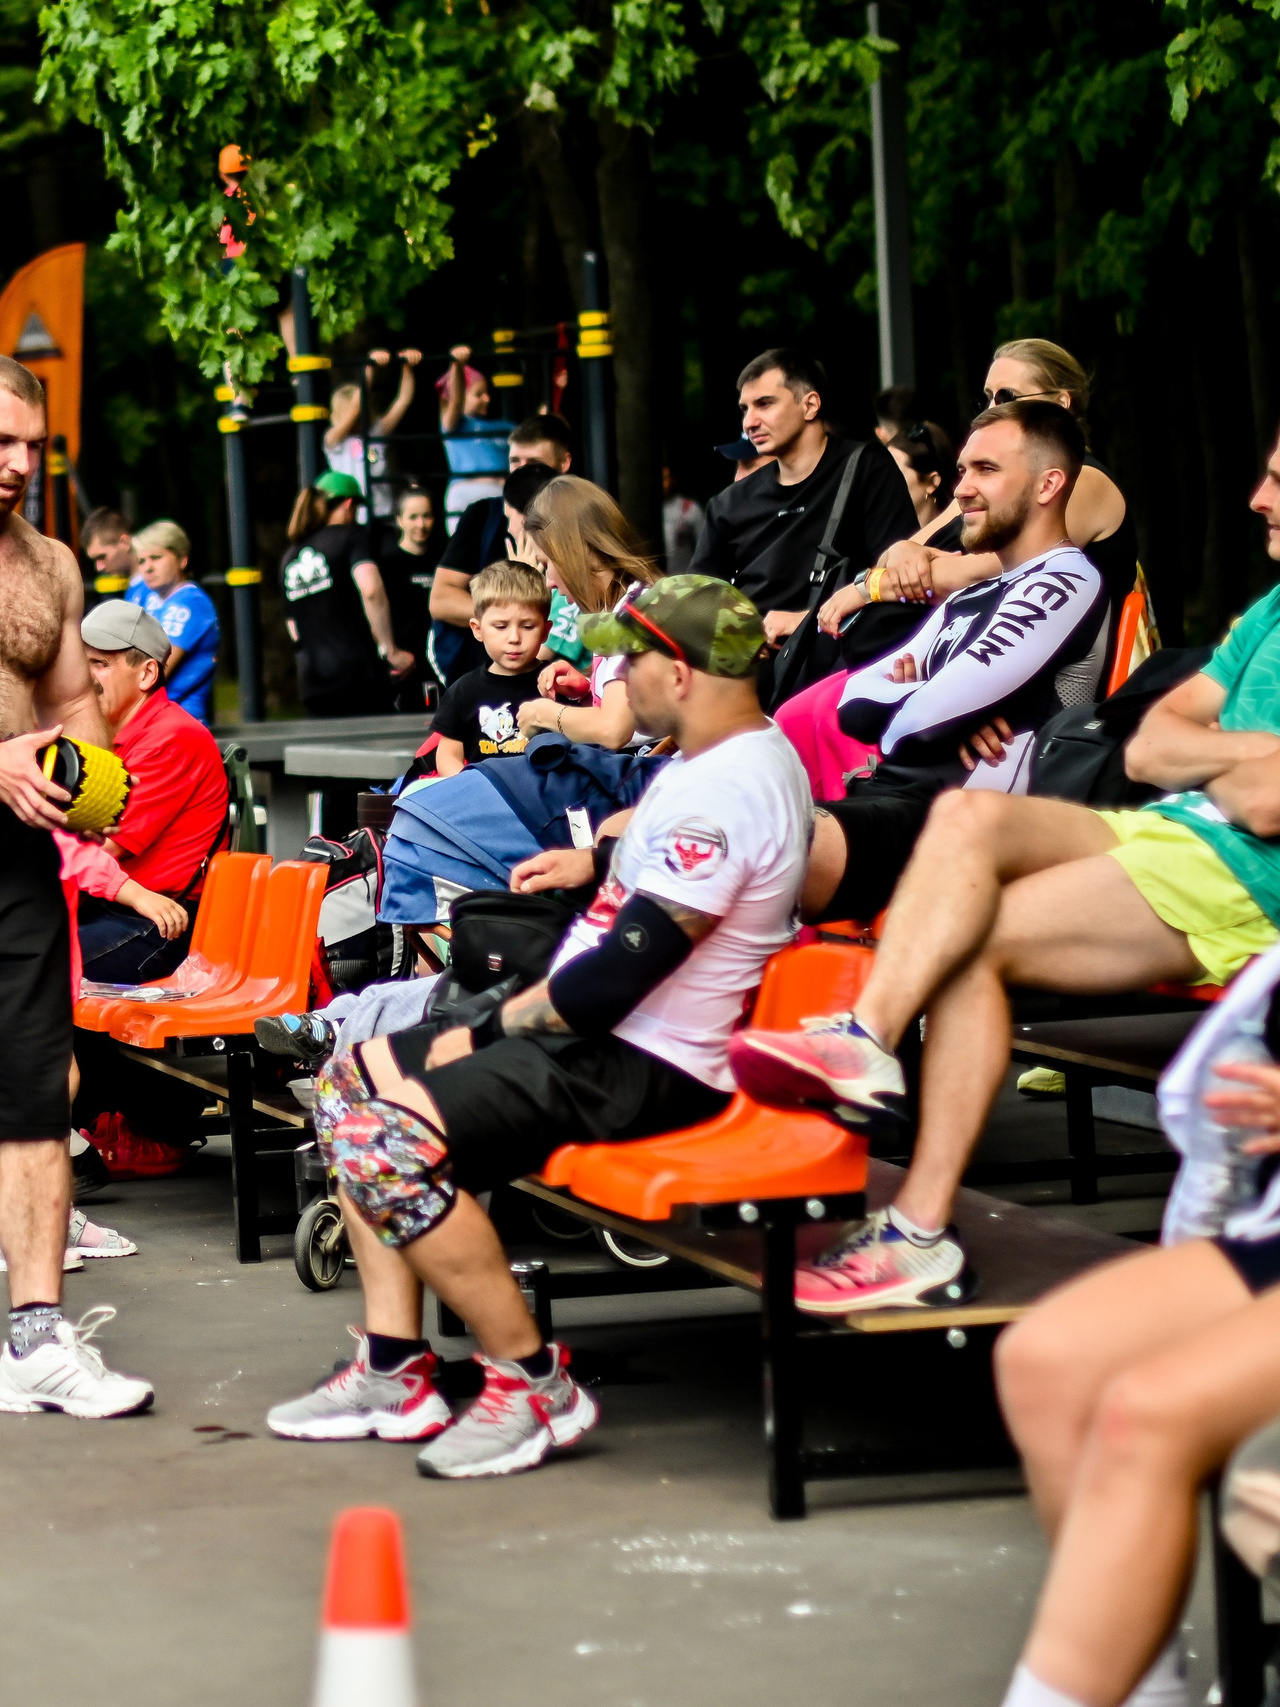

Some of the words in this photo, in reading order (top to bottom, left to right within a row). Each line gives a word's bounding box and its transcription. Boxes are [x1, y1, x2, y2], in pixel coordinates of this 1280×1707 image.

[164, 605, 191, 623] 20
[965, 571, 1088, 667] VENUM
[551, 617, 578, 642] 23
